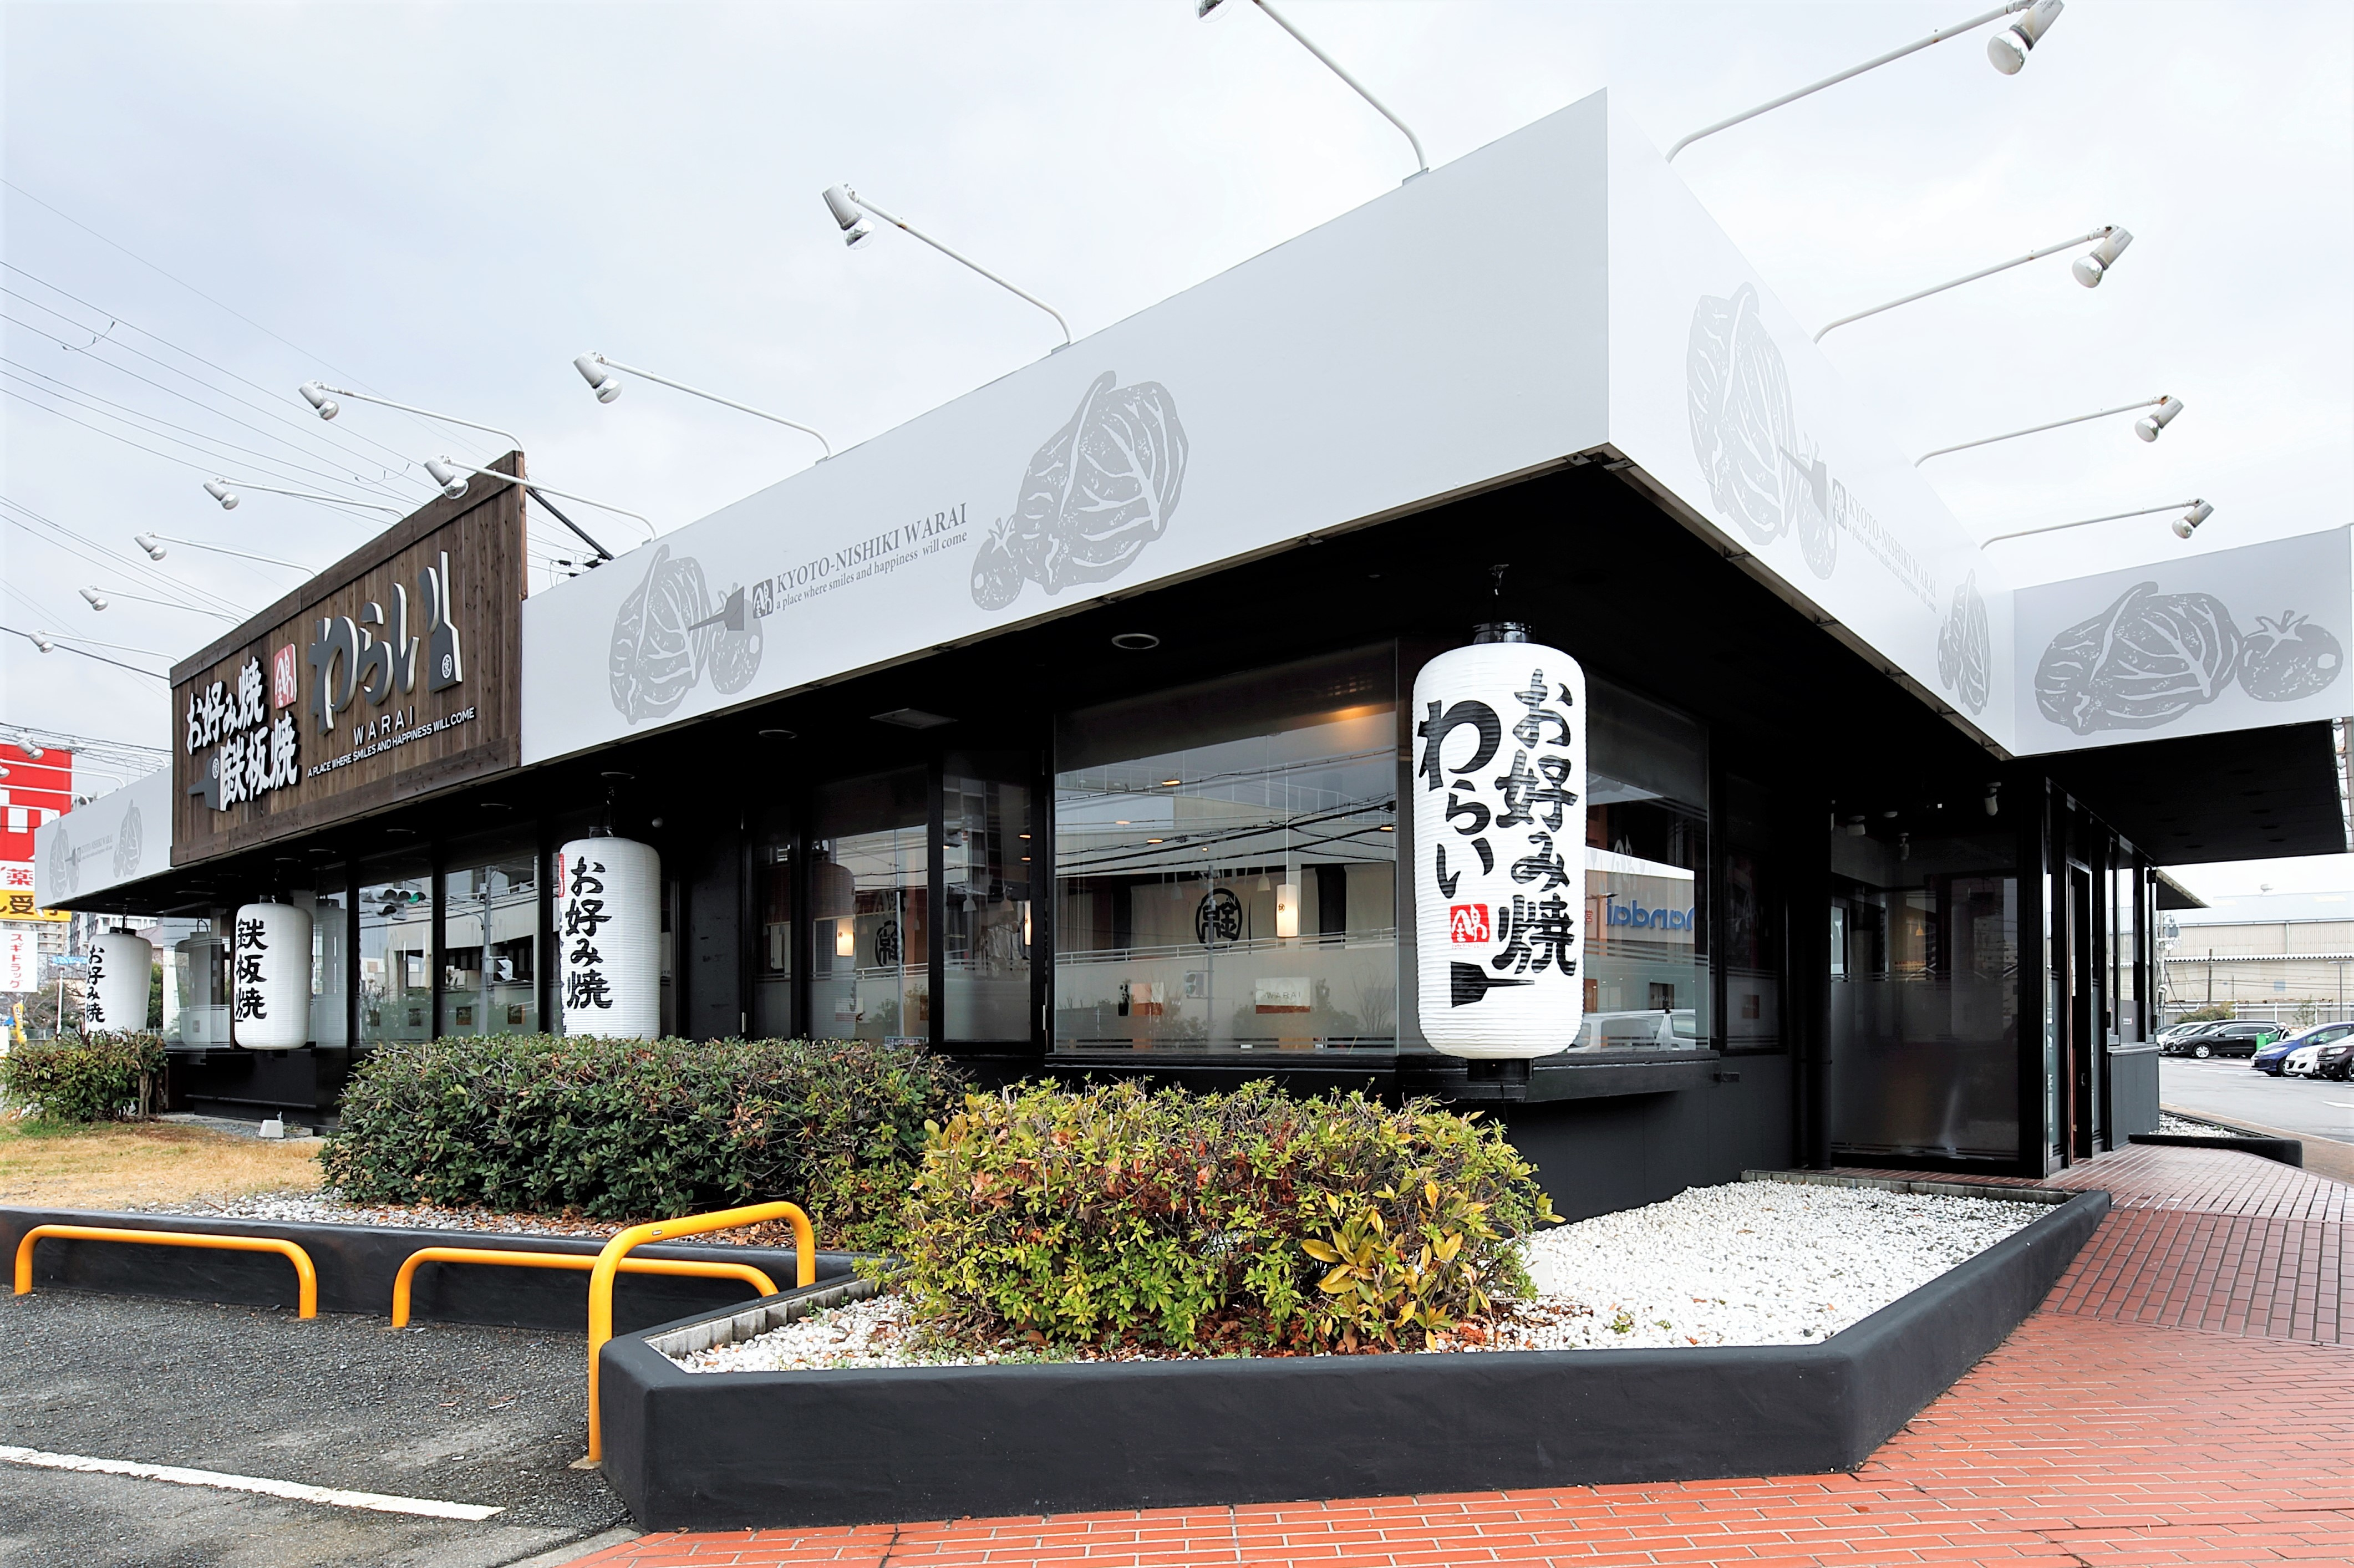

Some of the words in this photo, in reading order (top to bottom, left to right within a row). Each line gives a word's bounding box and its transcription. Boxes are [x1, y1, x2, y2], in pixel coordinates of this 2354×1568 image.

[776, 599, 781, 609] a
[782, 589, 802, 610] place
[804, 580, 827, 600] where
[828, 569, 855, 590] smiles
[856, 563, 873, 581] and
[874, 549, 918, 576] happiness
[922, 538, 939, 557] will
[941, 531, 968, 549] come
[777, 528, 900, 594] KYOTO-NISHIKI
[904, 502, 967, 545] WARAI
[1848, 492, 1912, 574] KYOTO-NISHIKI
[1913, 558, 1936, 598] WARAI
[308, 566, 440, 735] わらい
[186, 656, 264, 756] お好み焼
[307, 768, 312, 778] A
[313, 761, 332, 776] PLACE
[332, 753, 352, 769] WHERE
[353, 744, 377, 762] SMILES
[377, 738, 392, 753] AND
[392, 723, 432, 747] HAPPINESS
[433, 717, 450, 732] WILL
[450, 706, 475, 726] COME
[353, 705, 414, 746] WARAI
[1417, 699, 1502, 899] わらい
[1492, 668, 1579, 977] お好み焼
[9, 933, 23, 989] スギドラッグ
[236, 918, 269, 1020] 鉄板焼
[565, 856, 613, 1010] お好み焼
[87, 944, 106, 1024] お好み焼
